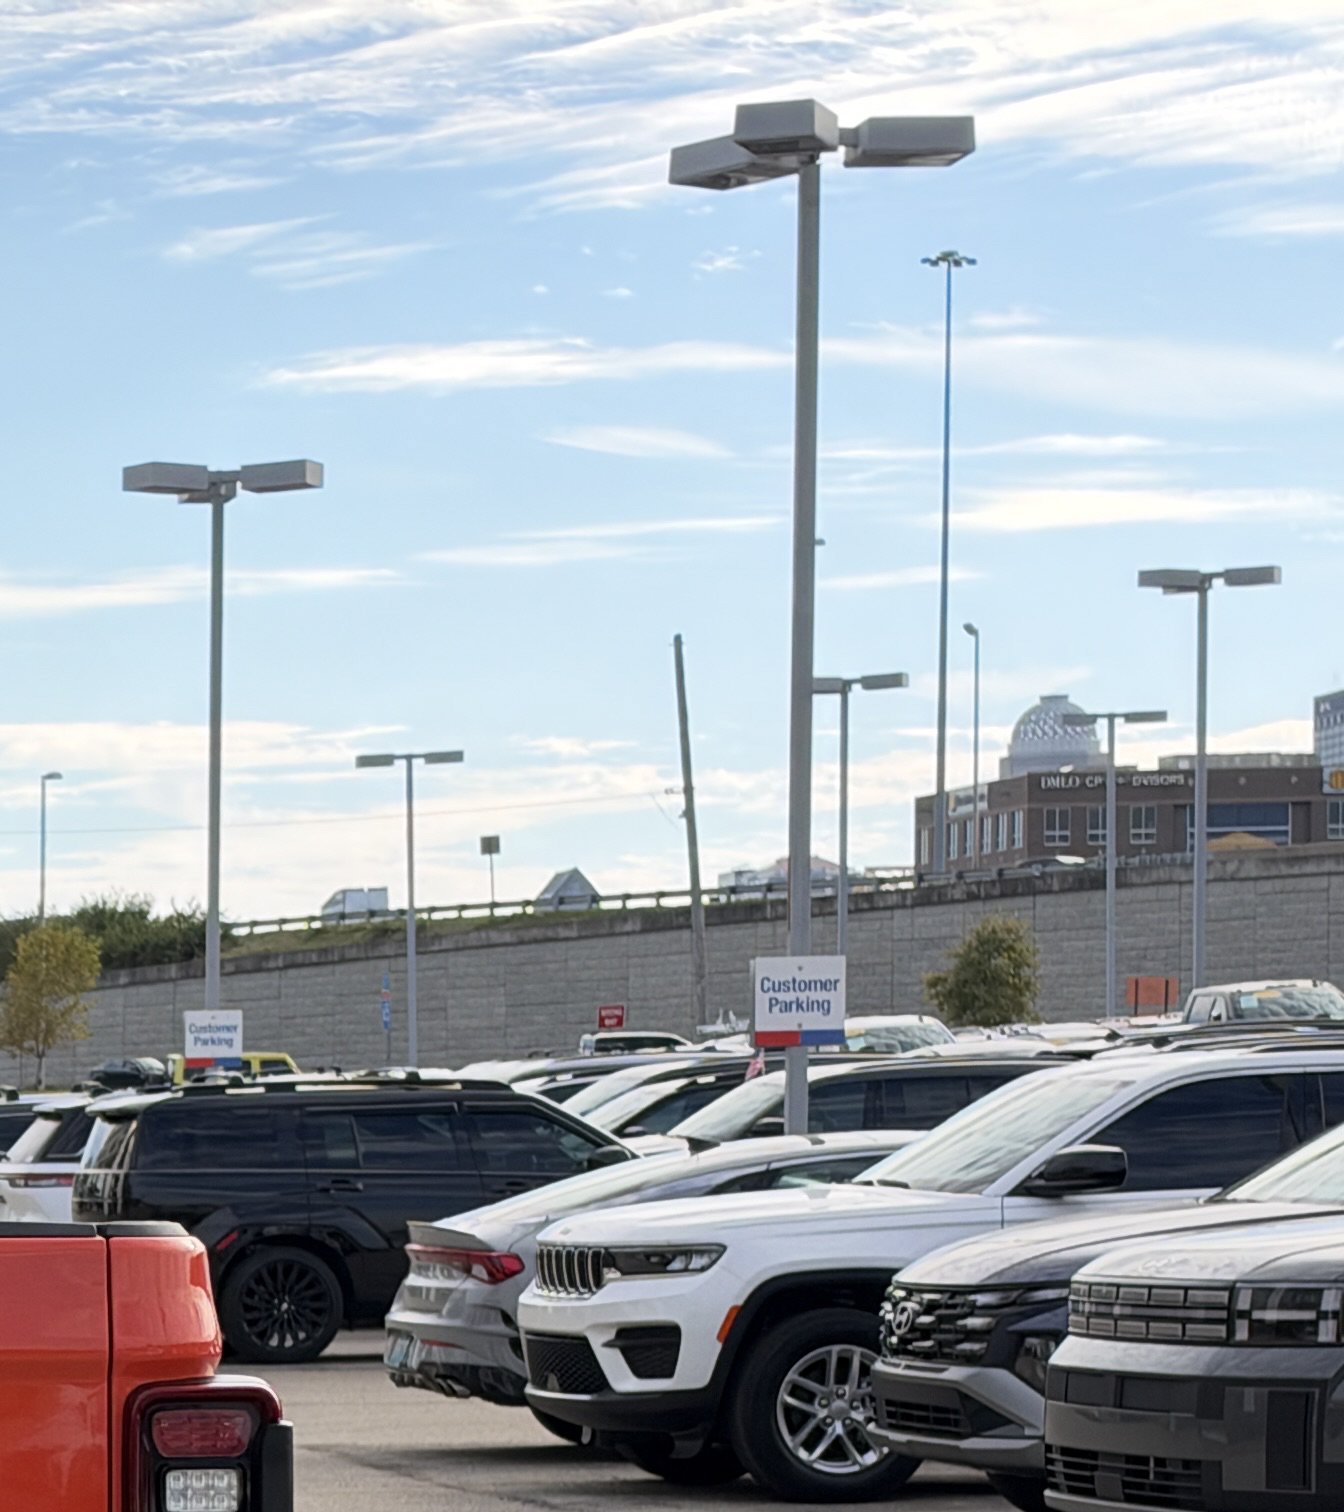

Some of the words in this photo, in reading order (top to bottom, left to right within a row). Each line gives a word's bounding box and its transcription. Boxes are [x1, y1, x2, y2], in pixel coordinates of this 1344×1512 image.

[760, 976, 840, 993] Customer
[768, 996, 831, 1016] Parking
[189, 1023, 238, 1034] Customer
[194, 1036, 234, 1048] Parking
